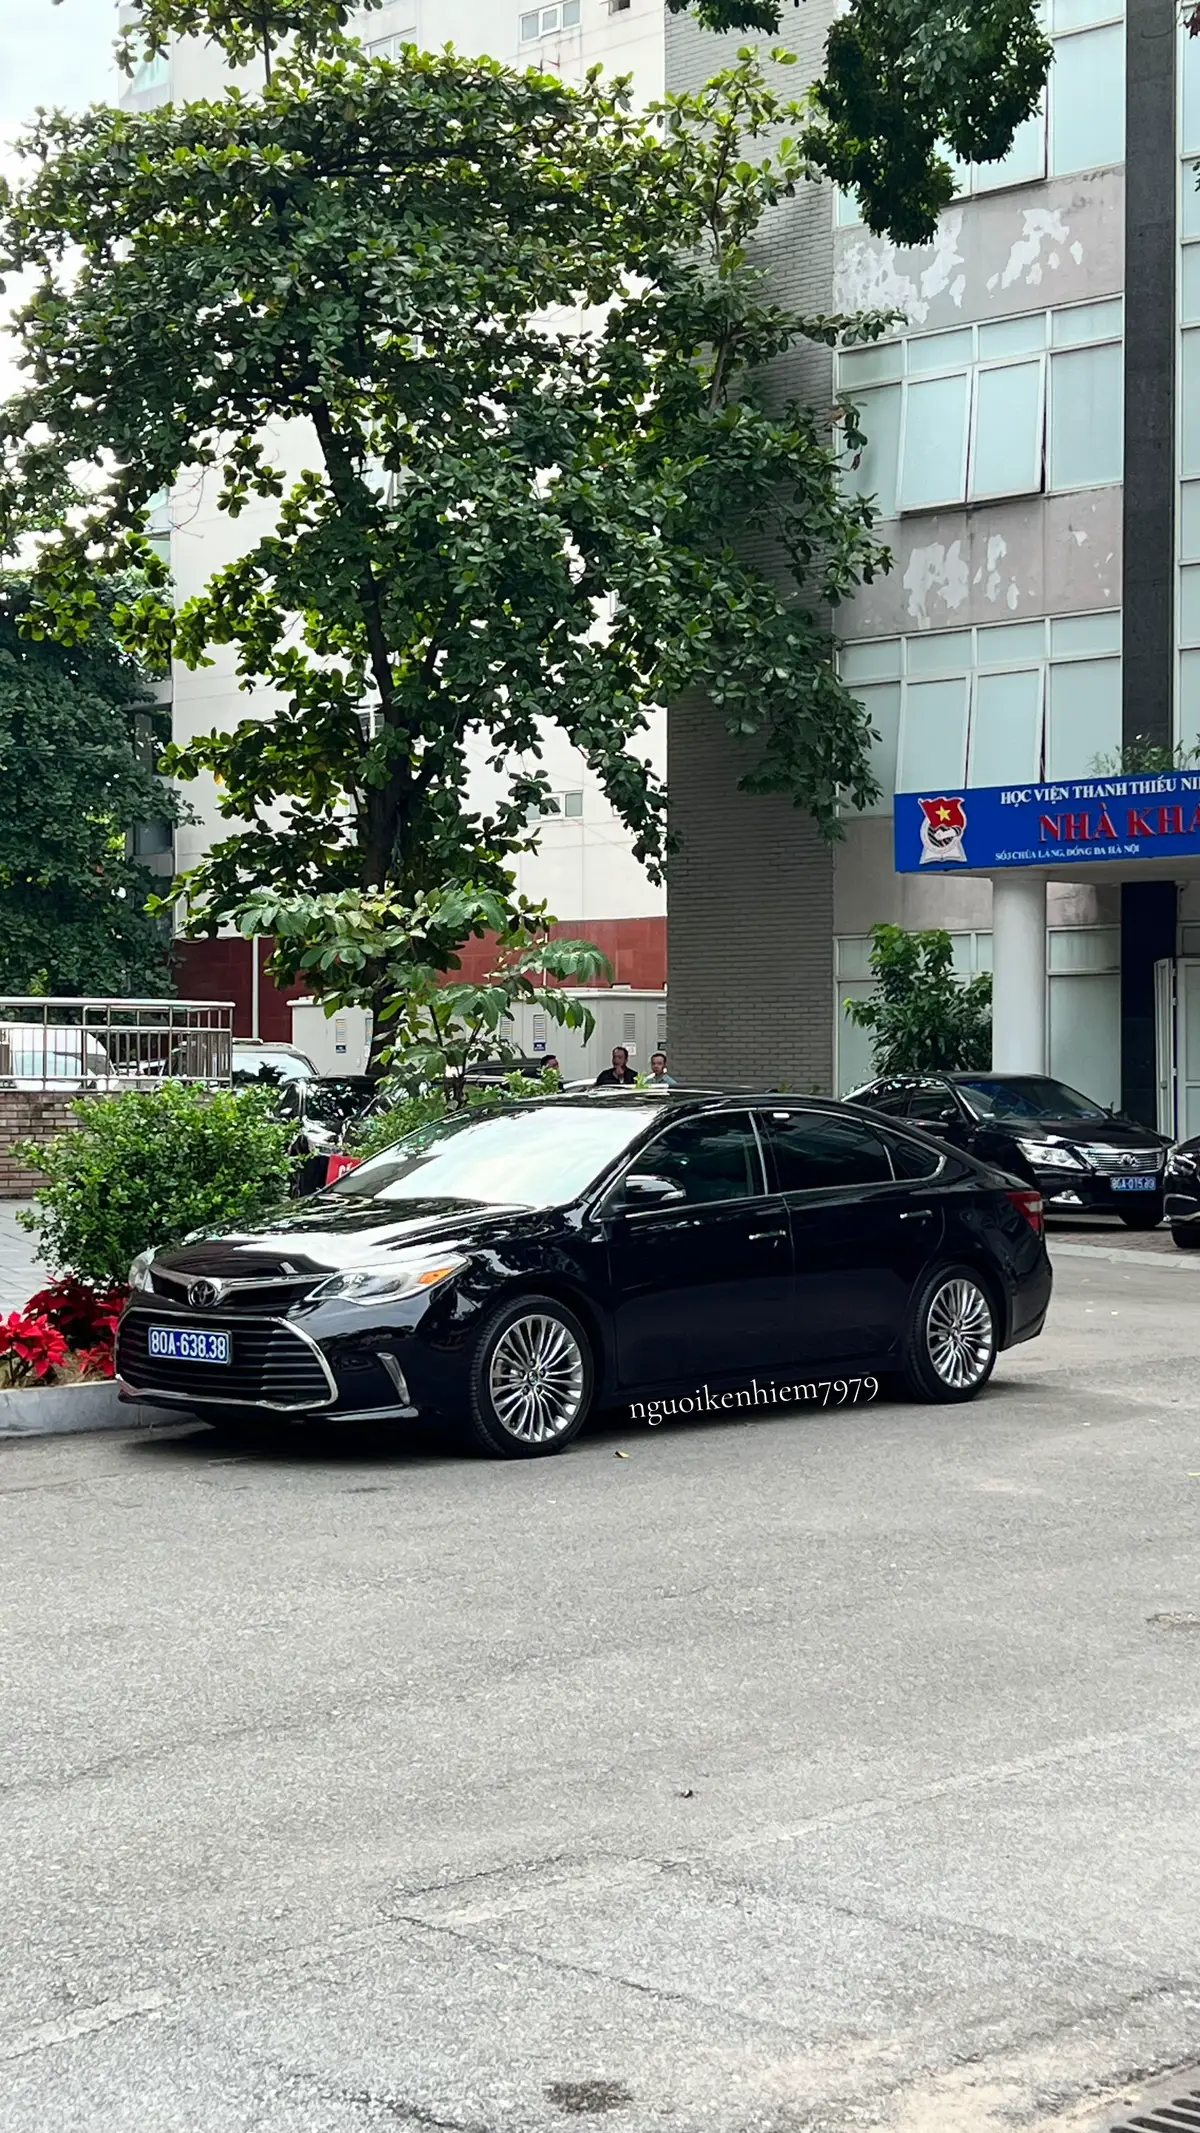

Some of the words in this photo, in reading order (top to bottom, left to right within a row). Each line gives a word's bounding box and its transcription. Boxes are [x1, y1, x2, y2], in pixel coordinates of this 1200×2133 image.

[1001, 790, 1031, 807] HỌC
[1034, 785, 1069, 804] VIỆN
[1072, 781, 1128, 799] THANH
[1129, 775, 1177, 794] THIẾU
[1039, 801, 1118, 842] NHÀ
[1108, 844, 1122, 854] HÀ
[1124, 843, 1139, 855] NỘI
